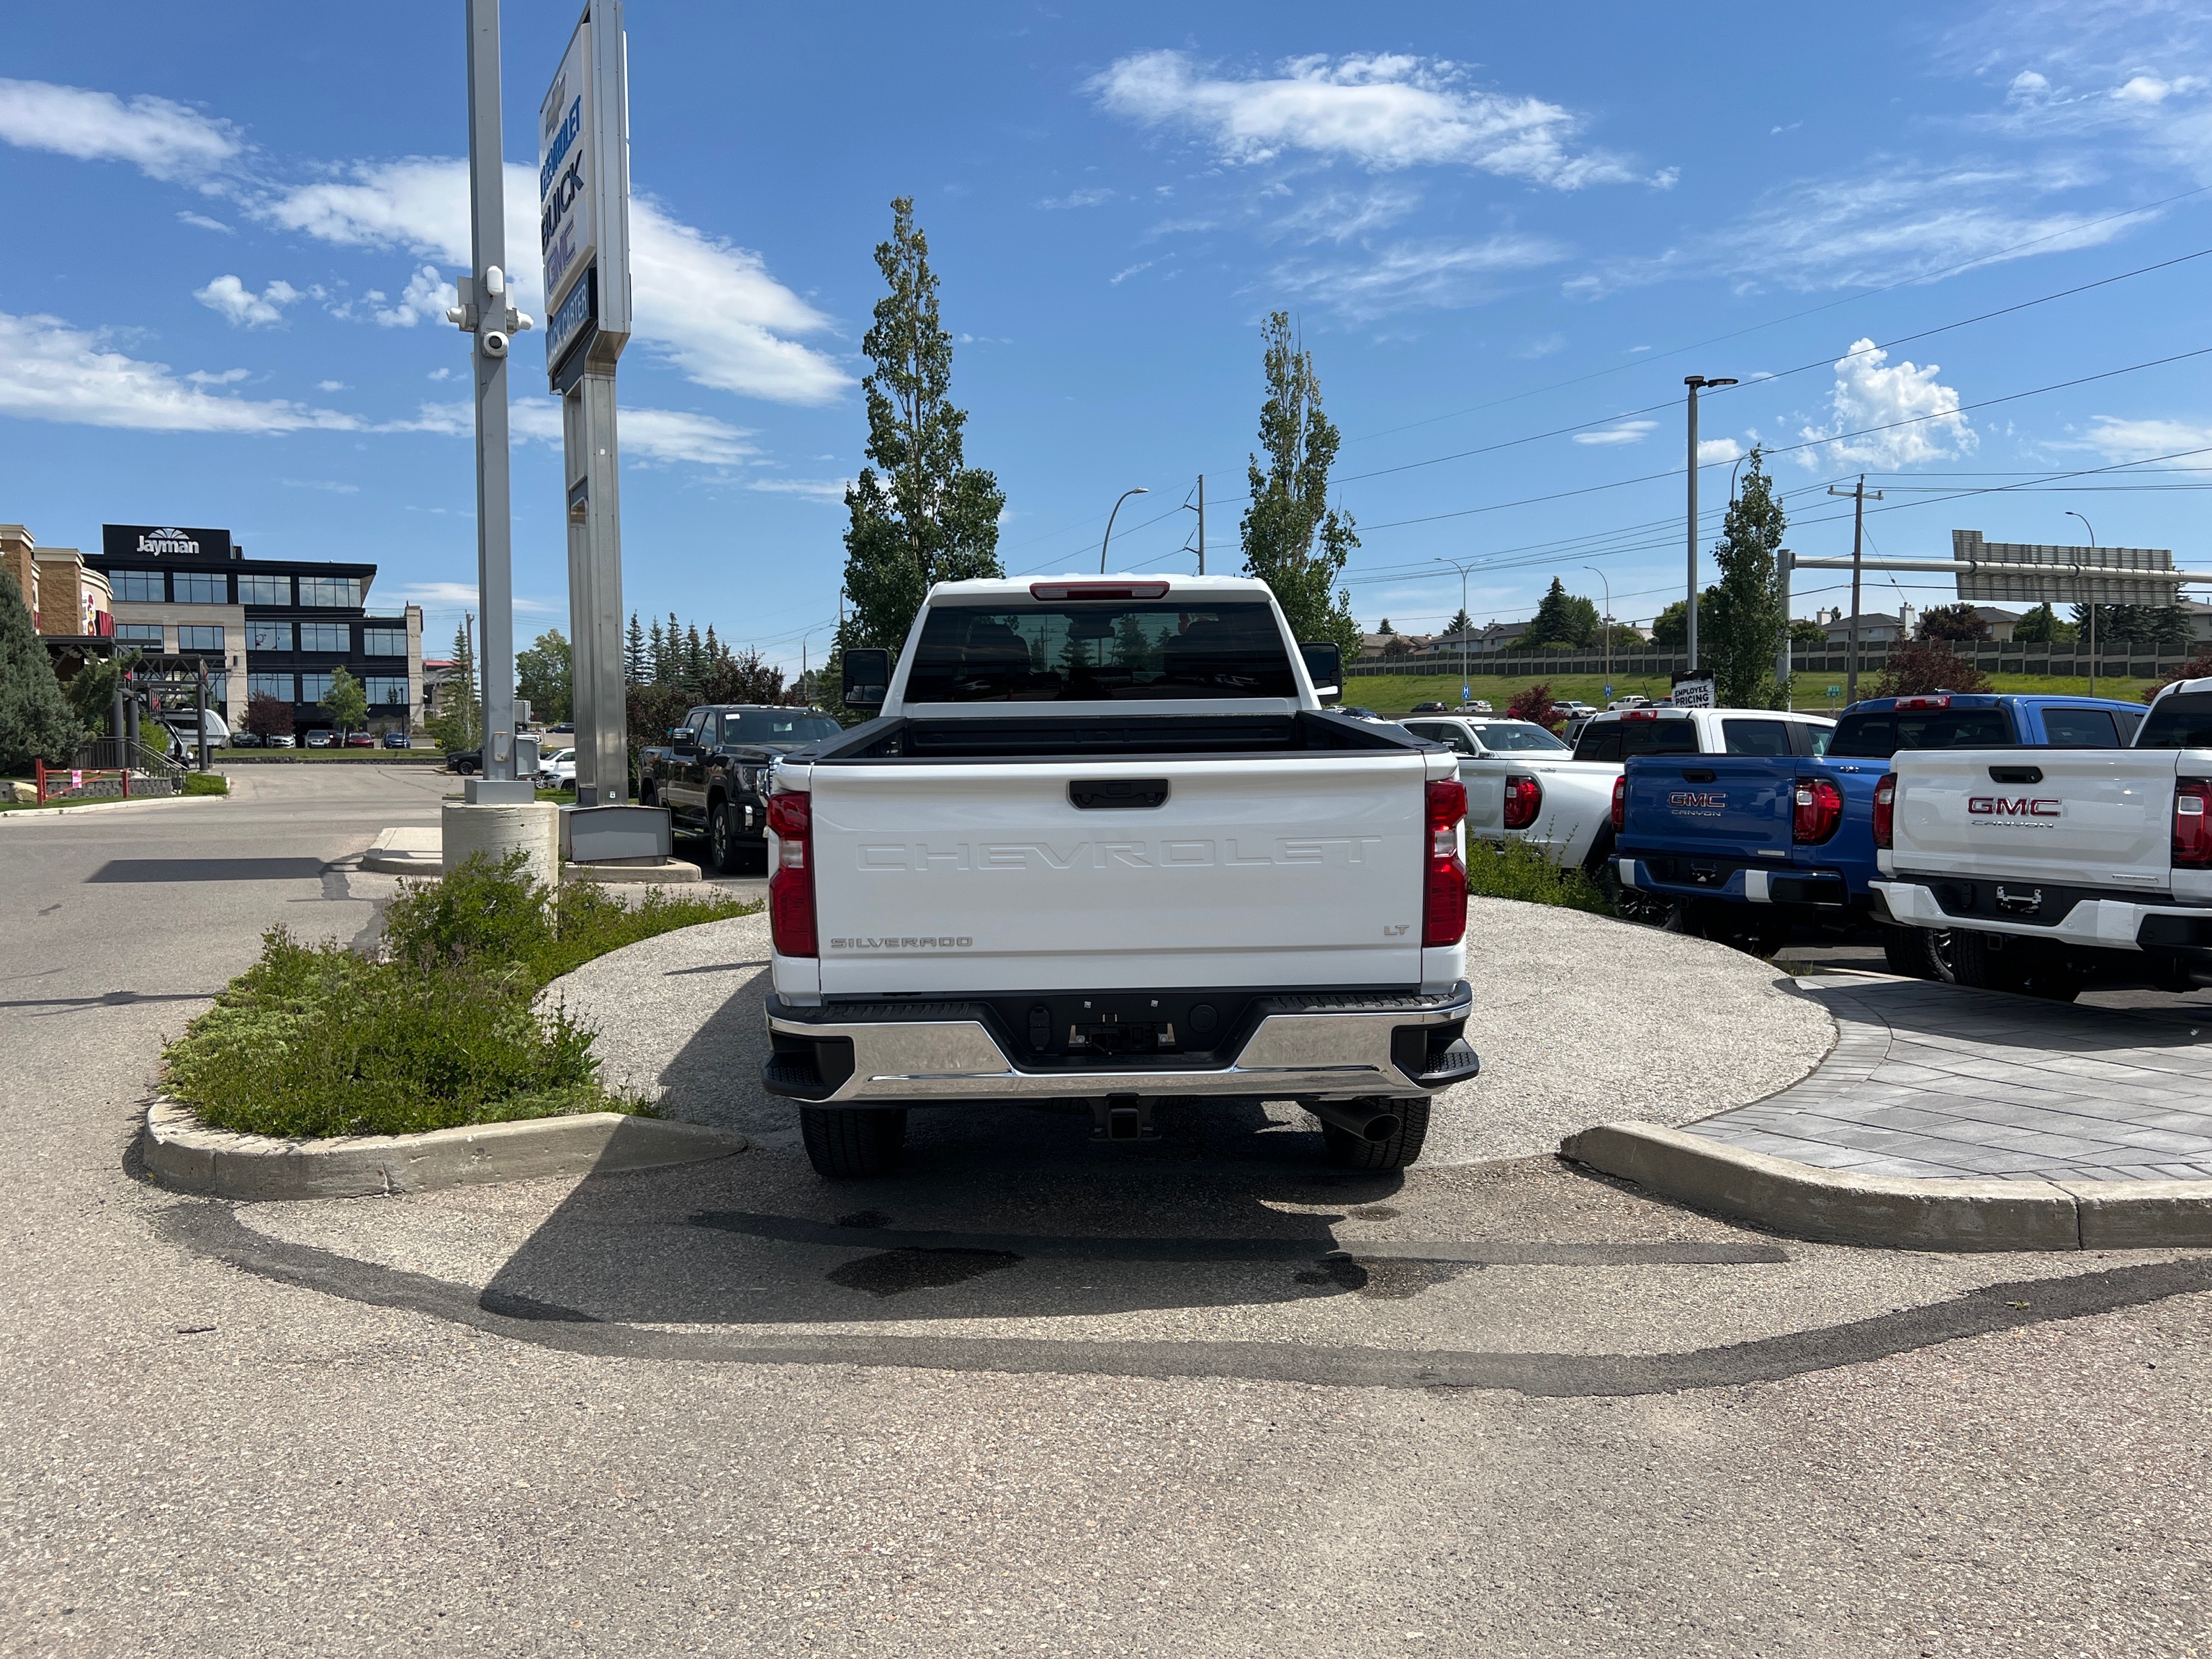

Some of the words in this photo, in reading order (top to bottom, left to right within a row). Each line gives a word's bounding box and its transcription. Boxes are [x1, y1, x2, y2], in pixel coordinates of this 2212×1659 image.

[540, 94, 581, 202] CHEVROLET
[541, 149, 584, 256] BUICK
[547, 215, 575, 295] GMC
[562, 283, 587, 341] CARTER
[136, 535, 199, 557] Jayman
[1674, 685, 1709, 697] EMPLOYEE
[1675, 693, 1709, 706] PRICING
[1669, 791, 1726, 808] GMC
[1968, 796, 2062, 817] GMC
[857, 835, 1382, 871] CHEVROLET
[1384, 925, 1410, 935] LT
[831, 937, 973, 948] SILVERADO
